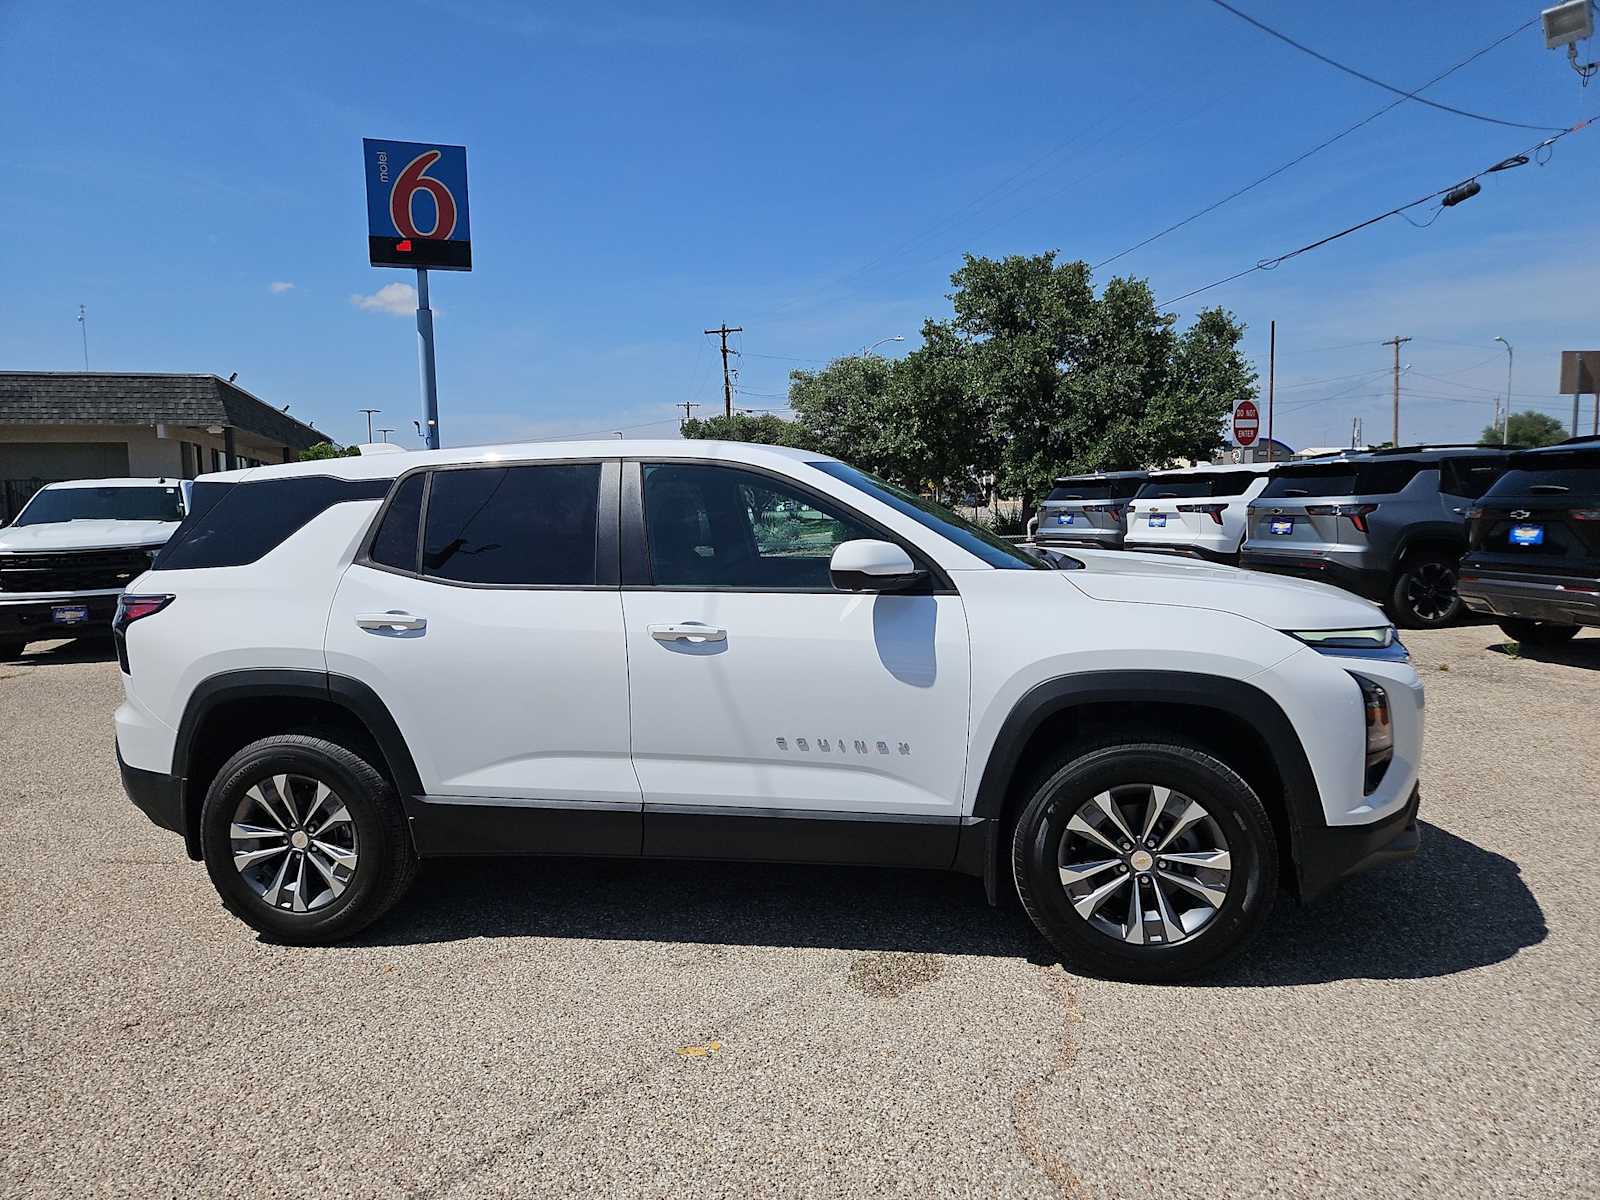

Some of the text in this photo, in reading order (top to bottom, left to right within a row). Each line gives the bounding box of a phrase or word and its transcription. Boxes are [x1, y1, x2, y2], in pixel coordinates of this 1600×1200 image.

[377, 149, 458, 241] motel 6
[1236, 409, 1256, 417] DO NOT
[1238, 430, 1254, 438] ENTER
[775, 737, 911, 756] EQUINOX
